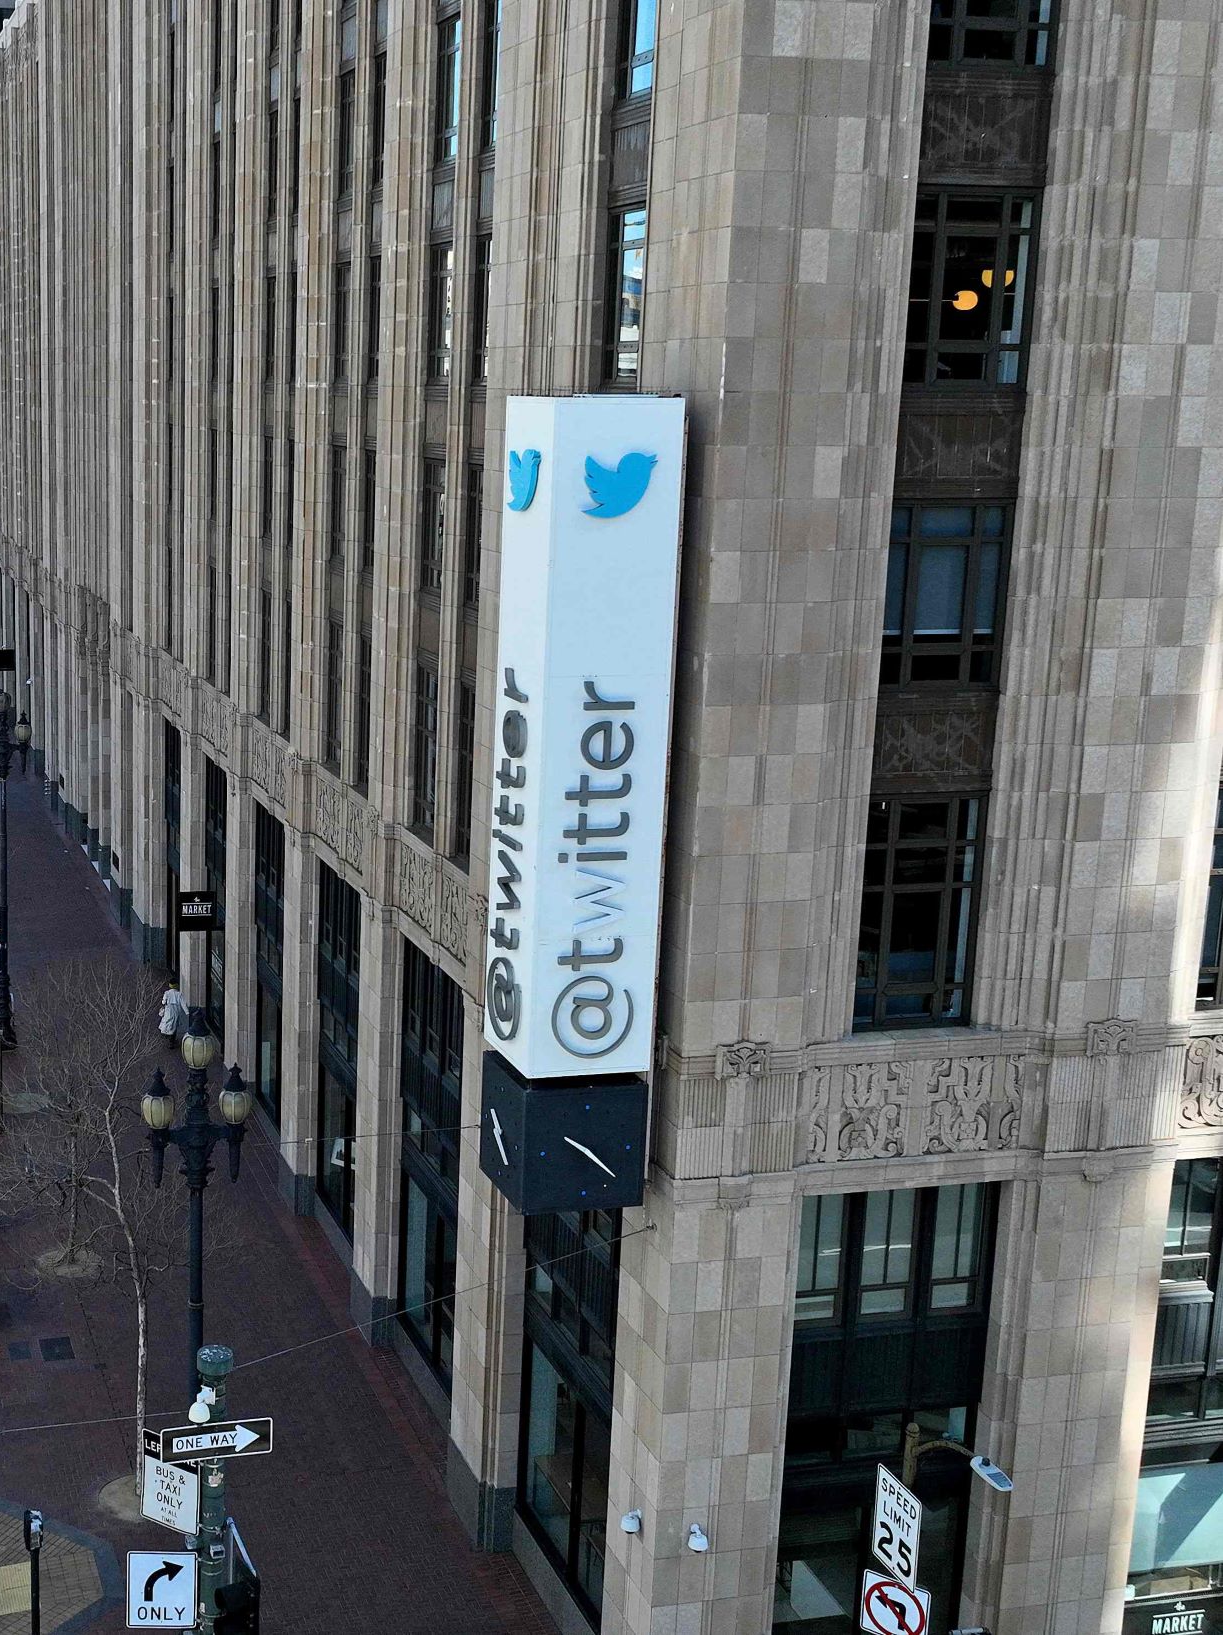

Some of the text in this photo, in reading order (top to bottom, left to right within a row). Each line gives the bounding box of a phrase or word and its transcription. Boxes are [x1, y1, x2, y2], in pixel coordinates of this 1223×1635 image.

[487, 667, 529, 1041] @twitter
[551, 681, 635, 1059] @twitter
[182, 905, 212, 914] MARKET
[176, 1432, 238, 1451] ONE WAY
[155, 1465, 186, 1486] BUS &
[160, 1480, 181, 1496] TAXI
[156, 1492, 183, 1510] ONLY
[881, 1477, 917, 1520] SPEED
[161, 1515, 176, 1526] TIMES
[168, 1509, 178, 1518] ALL
[883, 1500, 912, 1537] LIMIT
[877, 1521, 912, 1578] 25
[137, 1606, 186, 1621] ONLY
[1151, 1613, 1205, 1635] MARKET
